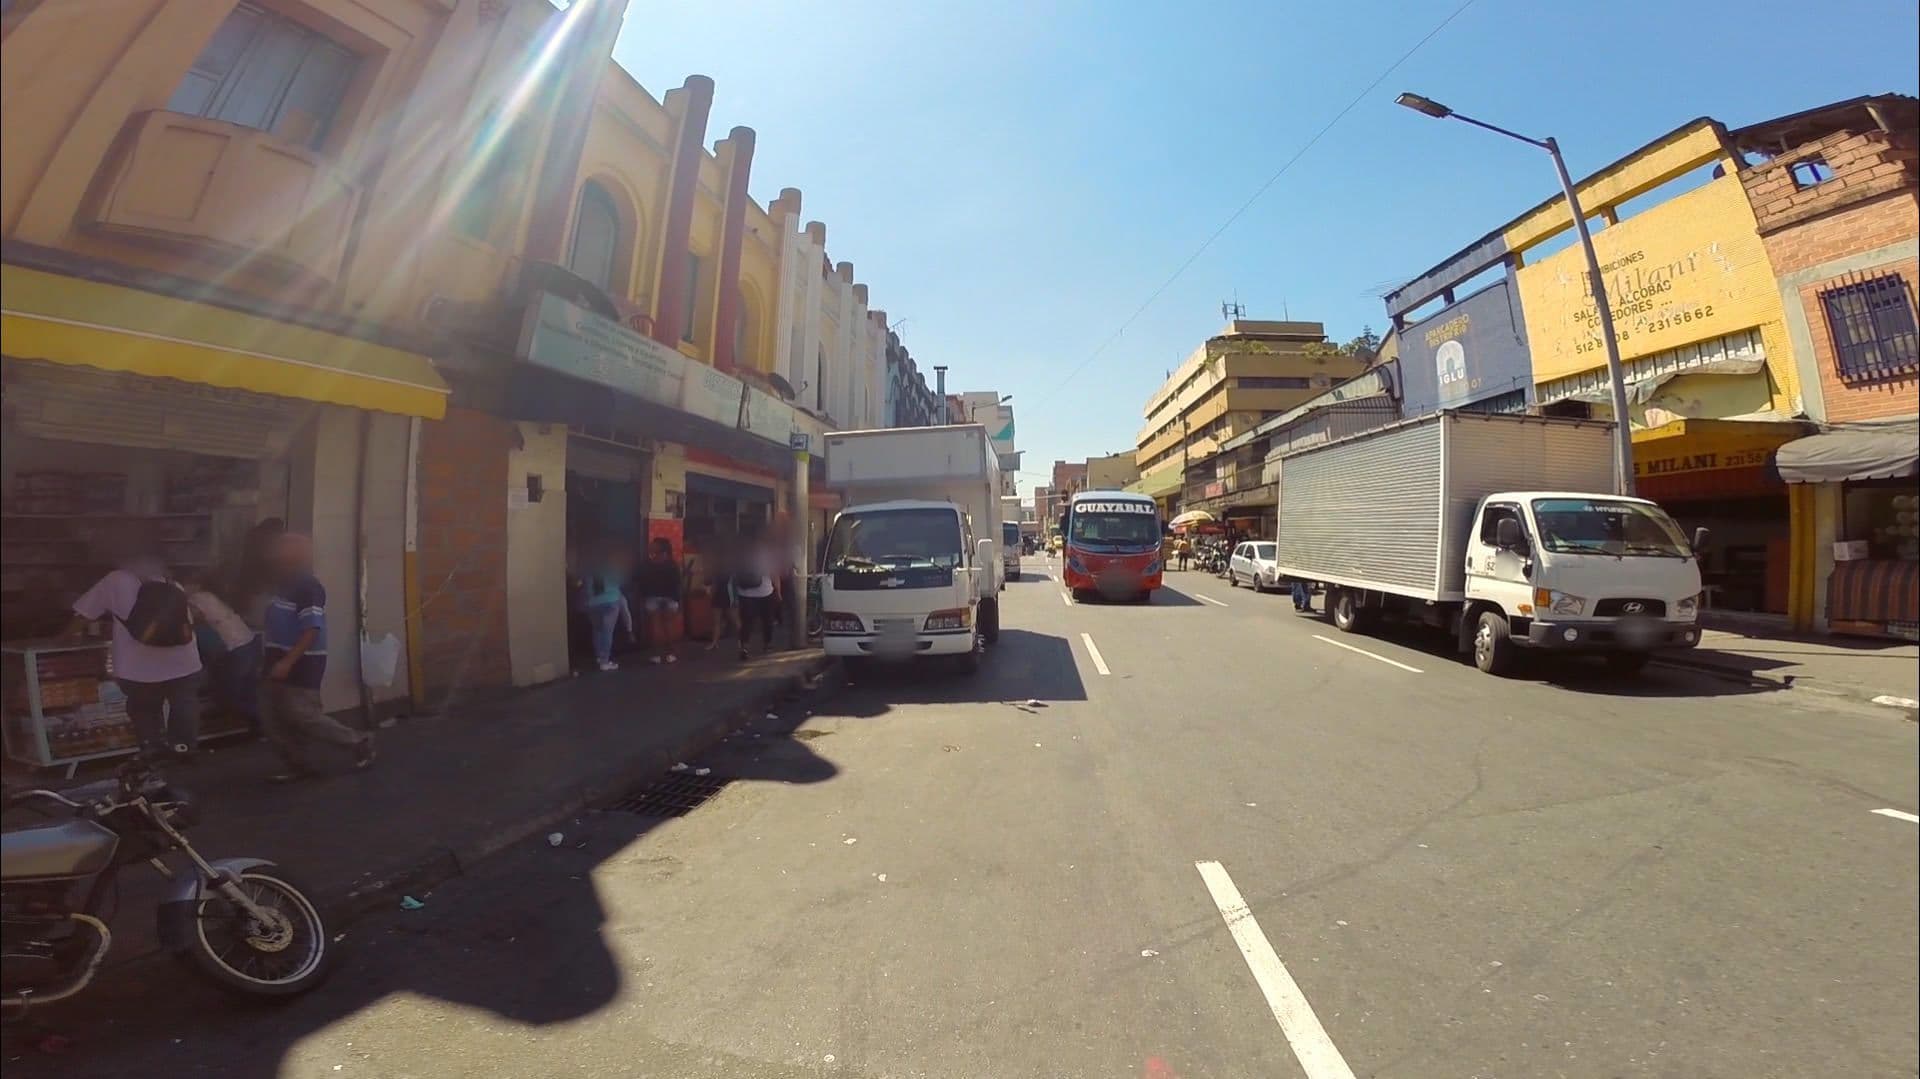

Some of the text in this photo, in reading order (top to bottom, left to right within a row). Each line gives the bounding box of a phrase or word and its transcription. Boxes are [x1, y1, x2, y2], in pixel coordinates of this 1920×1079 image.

[1619, 280, 1673, 307] ALCOBAS
[1587, 299, 1654, 330] COEDORES
[1440, 368, 1465, 385] IGLU
[1648, 453, 1717, 474] MILANI
[1075, 503, 1155, 515] GUAYABAL
